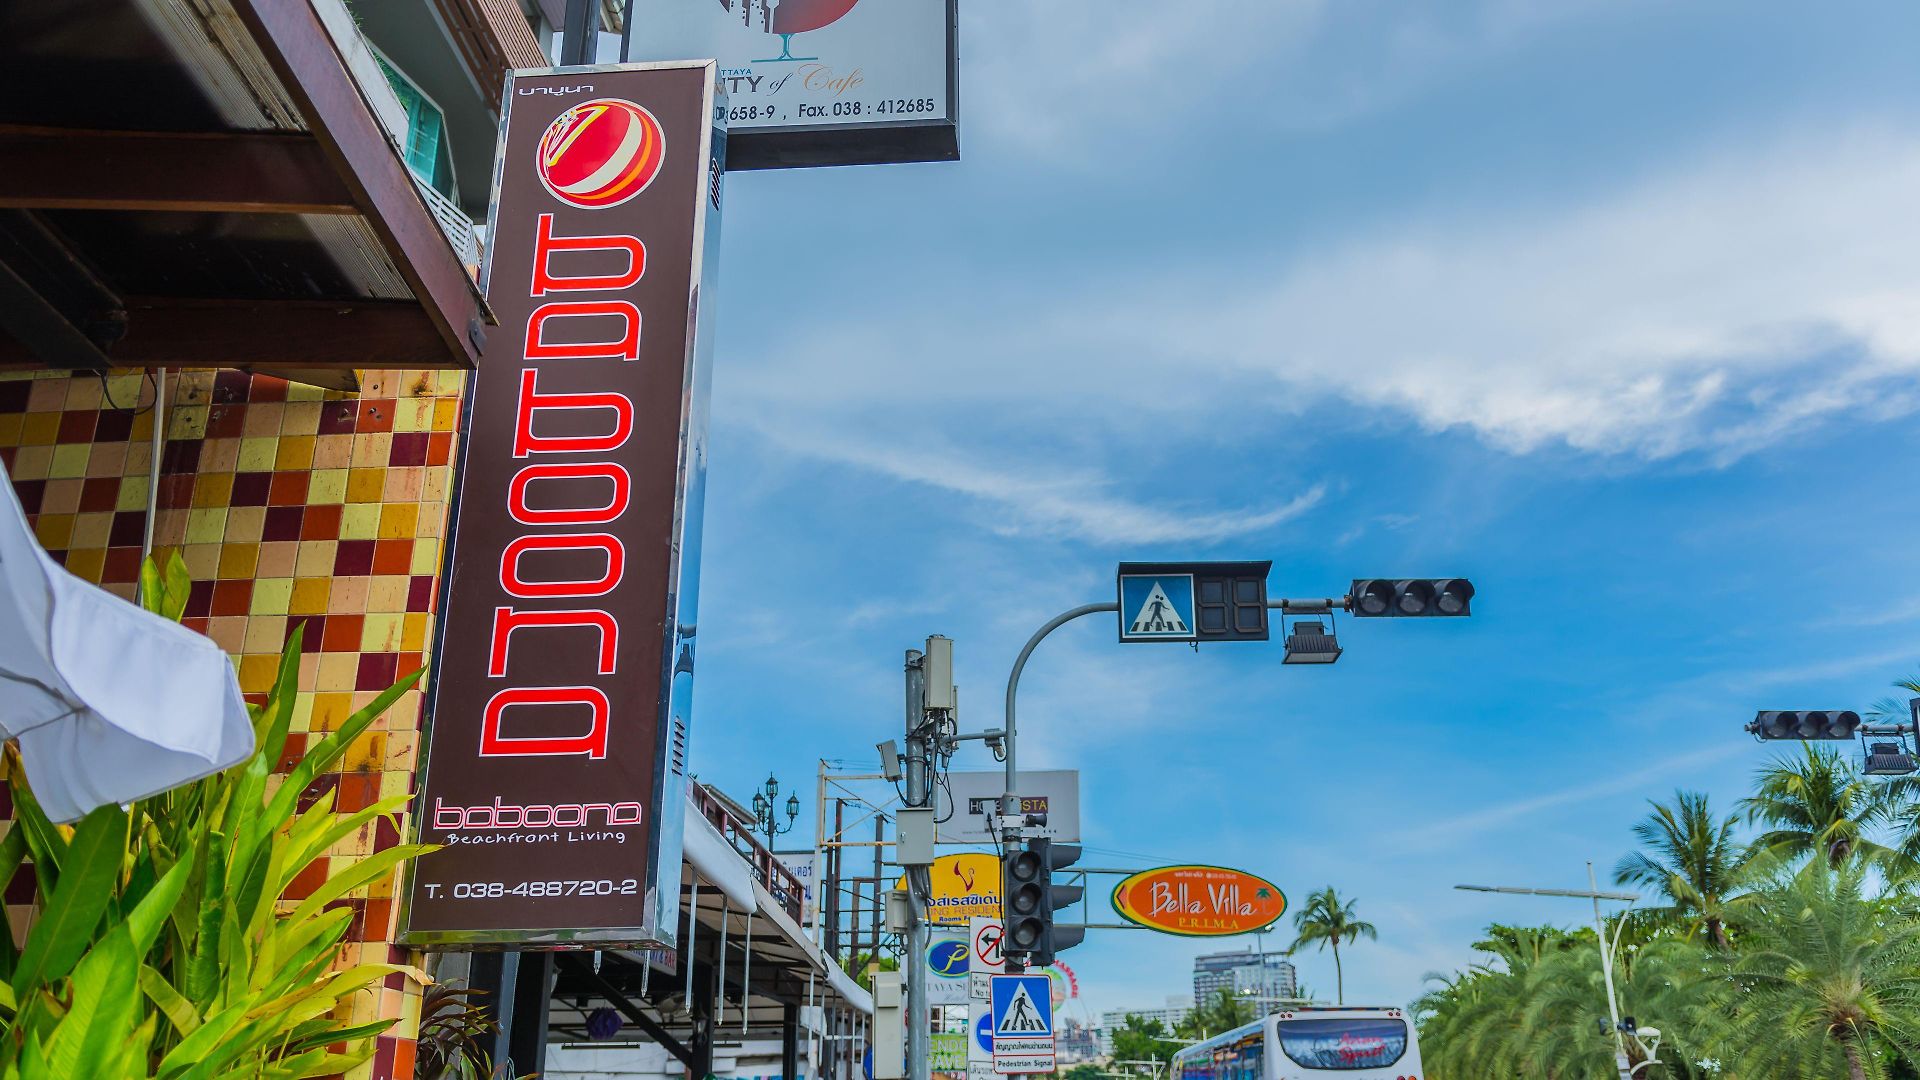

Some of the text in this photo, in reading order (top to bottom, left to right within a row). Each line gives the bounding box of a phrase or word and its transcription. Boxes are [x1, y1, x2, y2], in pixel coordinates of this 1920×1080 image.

[766, 73, 795, 97] of
[798, 103, 828, 118] Fax.
[877, 98, 935, 114] 412685
[433, 796, 642, 830] baboona
[446, 831, 625, 846] Beachfront Living
[424, 879, 638, 899] T. 038-488720-2
[1149, 881, 1257, 917] Bella Villa
[1178, 917, 1239, 929] PRIMA
